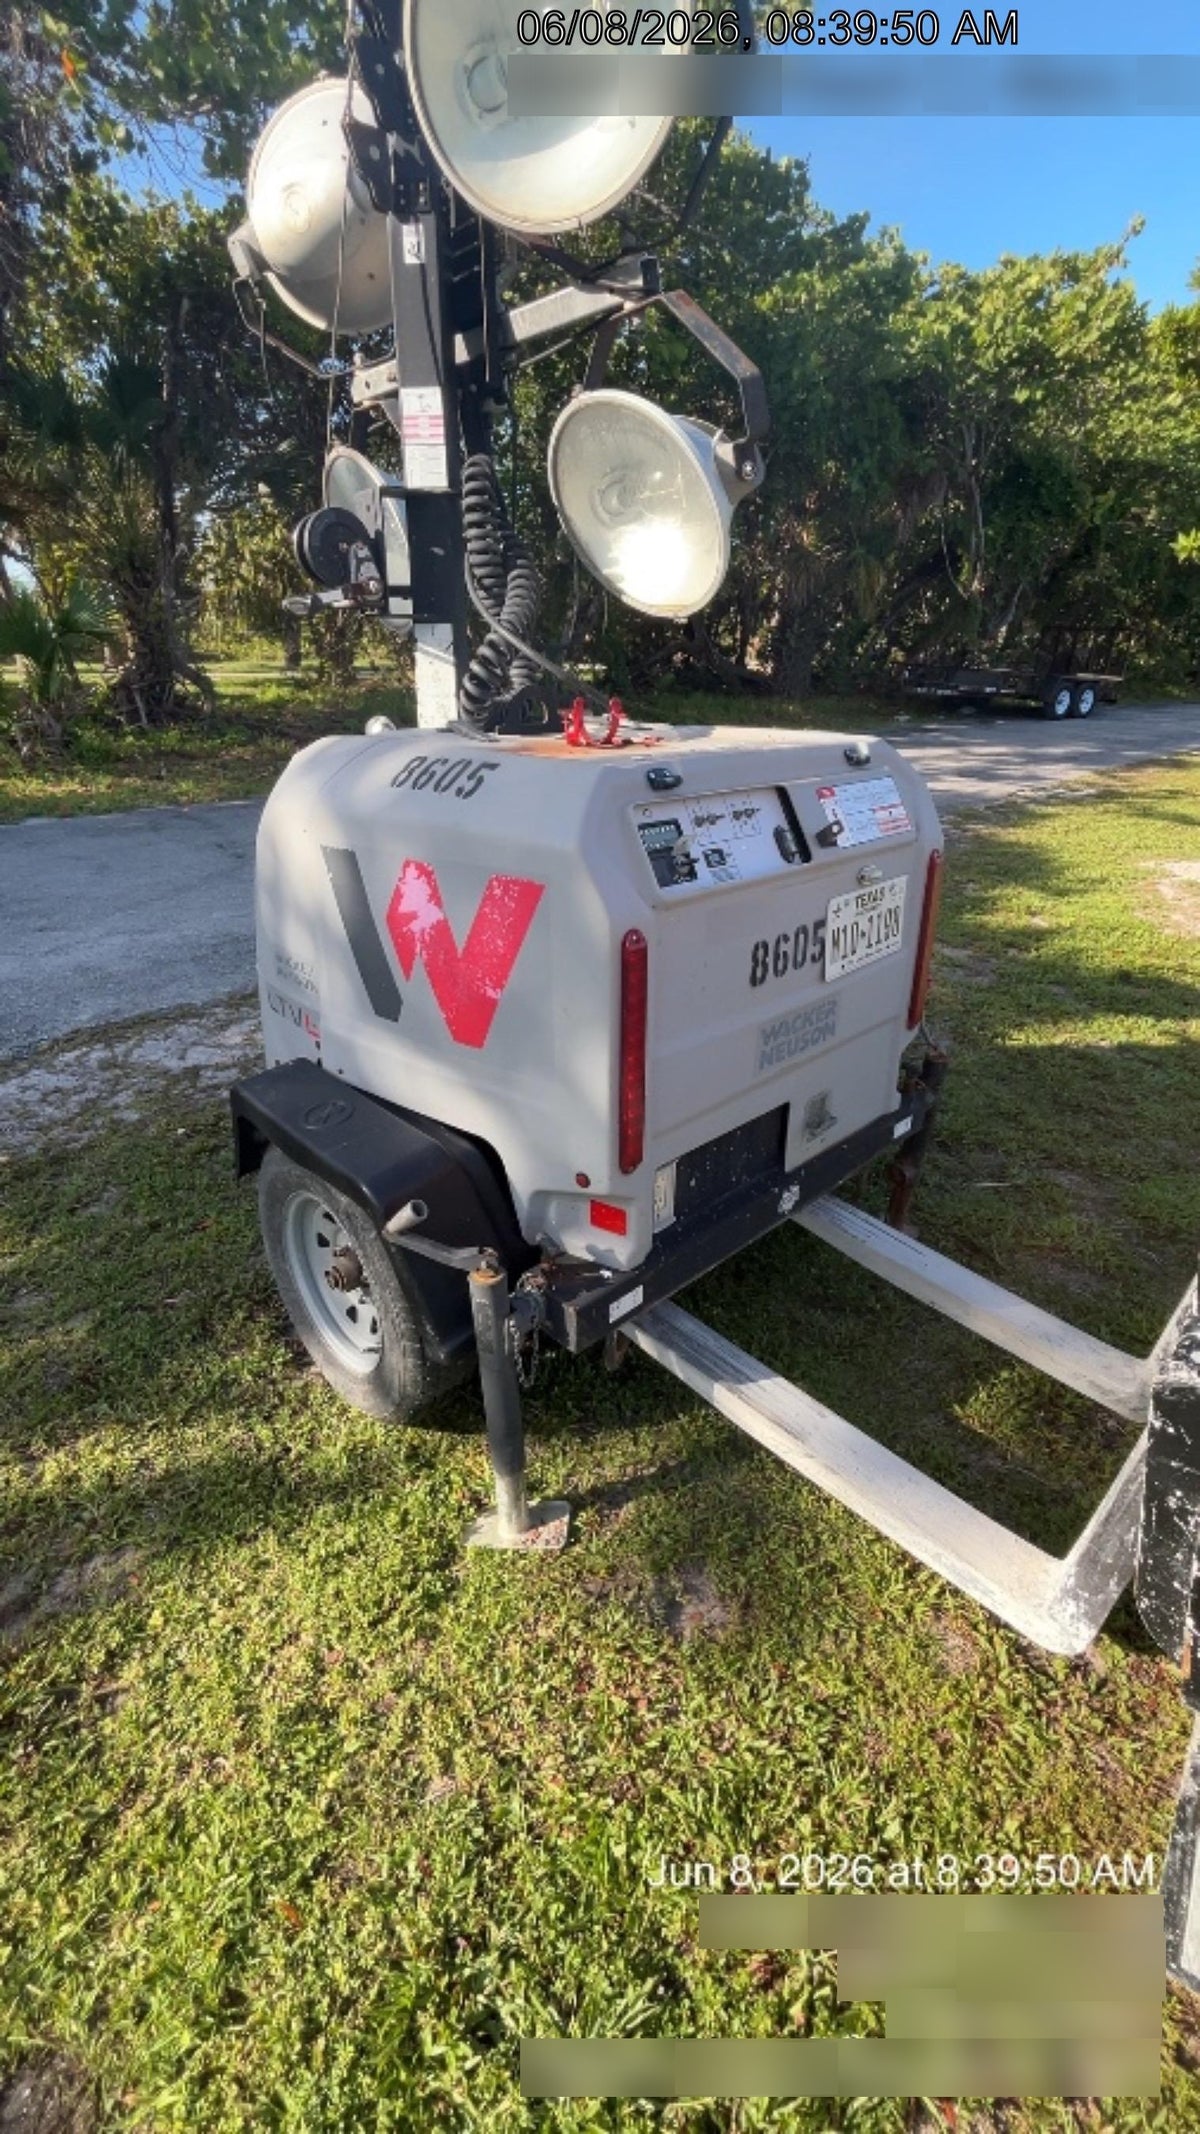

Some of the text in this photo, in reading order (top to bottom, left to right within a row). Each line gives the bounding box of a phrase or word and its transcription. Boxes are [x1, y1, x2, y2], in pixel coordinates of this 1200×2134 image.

[391, 756, 501, 799] 8605
[749, 919, 826, 987] 8605
[759, 1020, 836, 1070] NEUSON
[760, 1000, 838, 1046] WACKER
